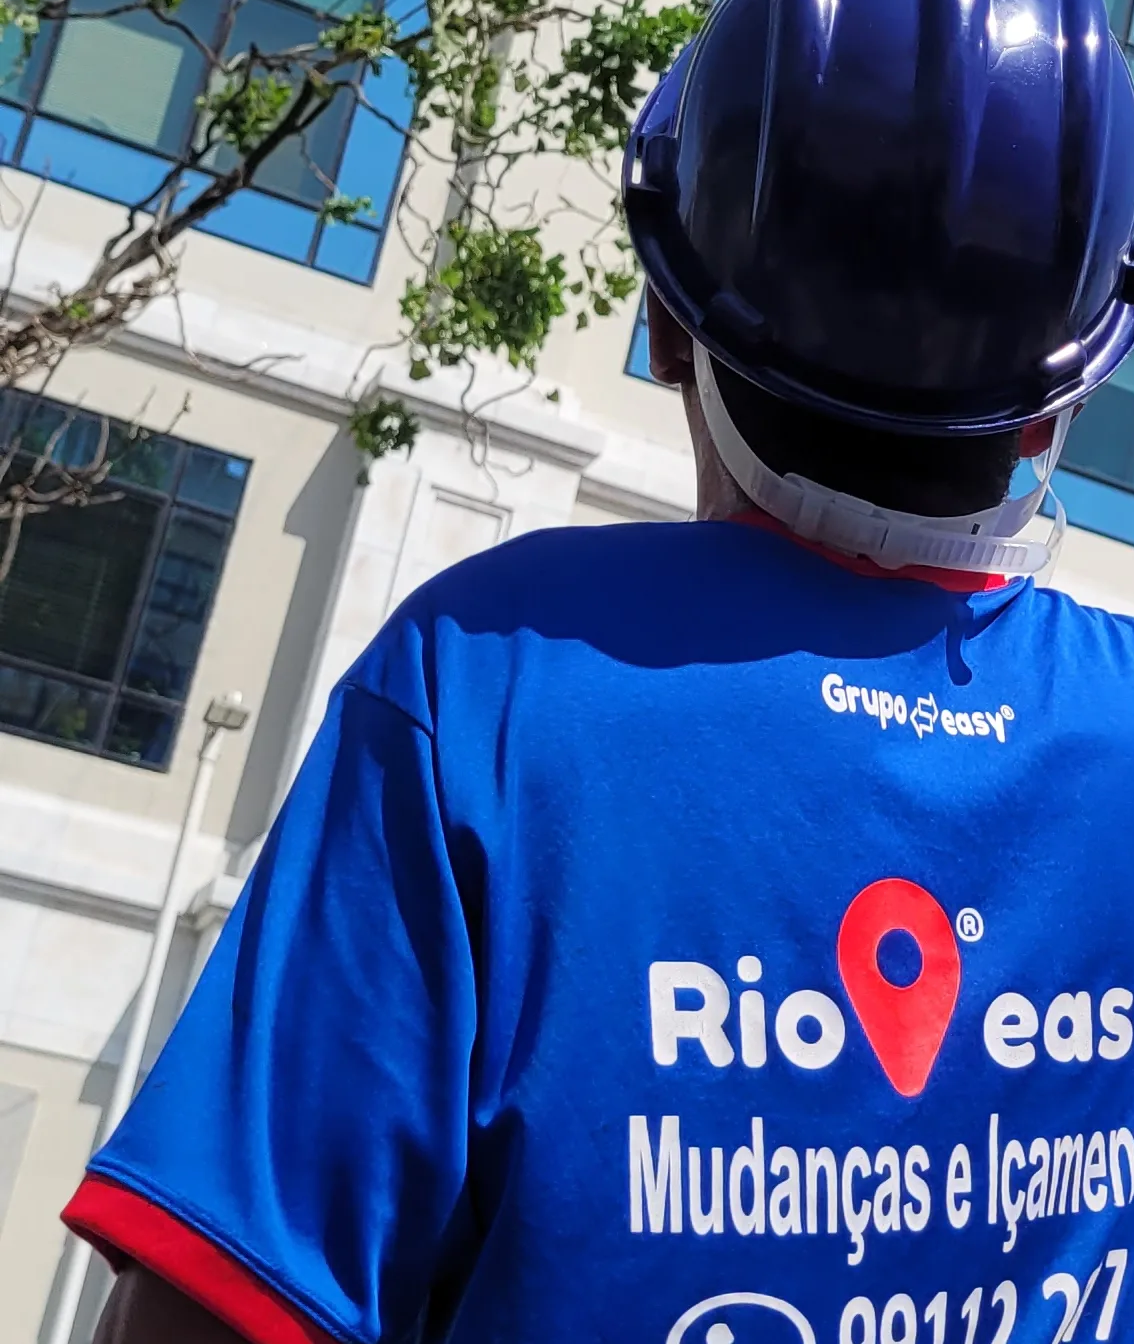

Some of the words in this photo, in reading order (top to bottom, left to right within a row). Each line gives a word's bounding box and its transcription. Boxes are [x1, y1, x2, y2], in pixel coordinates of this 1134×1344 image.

[822, 673, 908, 730] Grupo
[649, 955, 846, 1070] Rio
[629, 1115, 931, 1266] Mudanças
[945, 1143, 972, 1229] e
